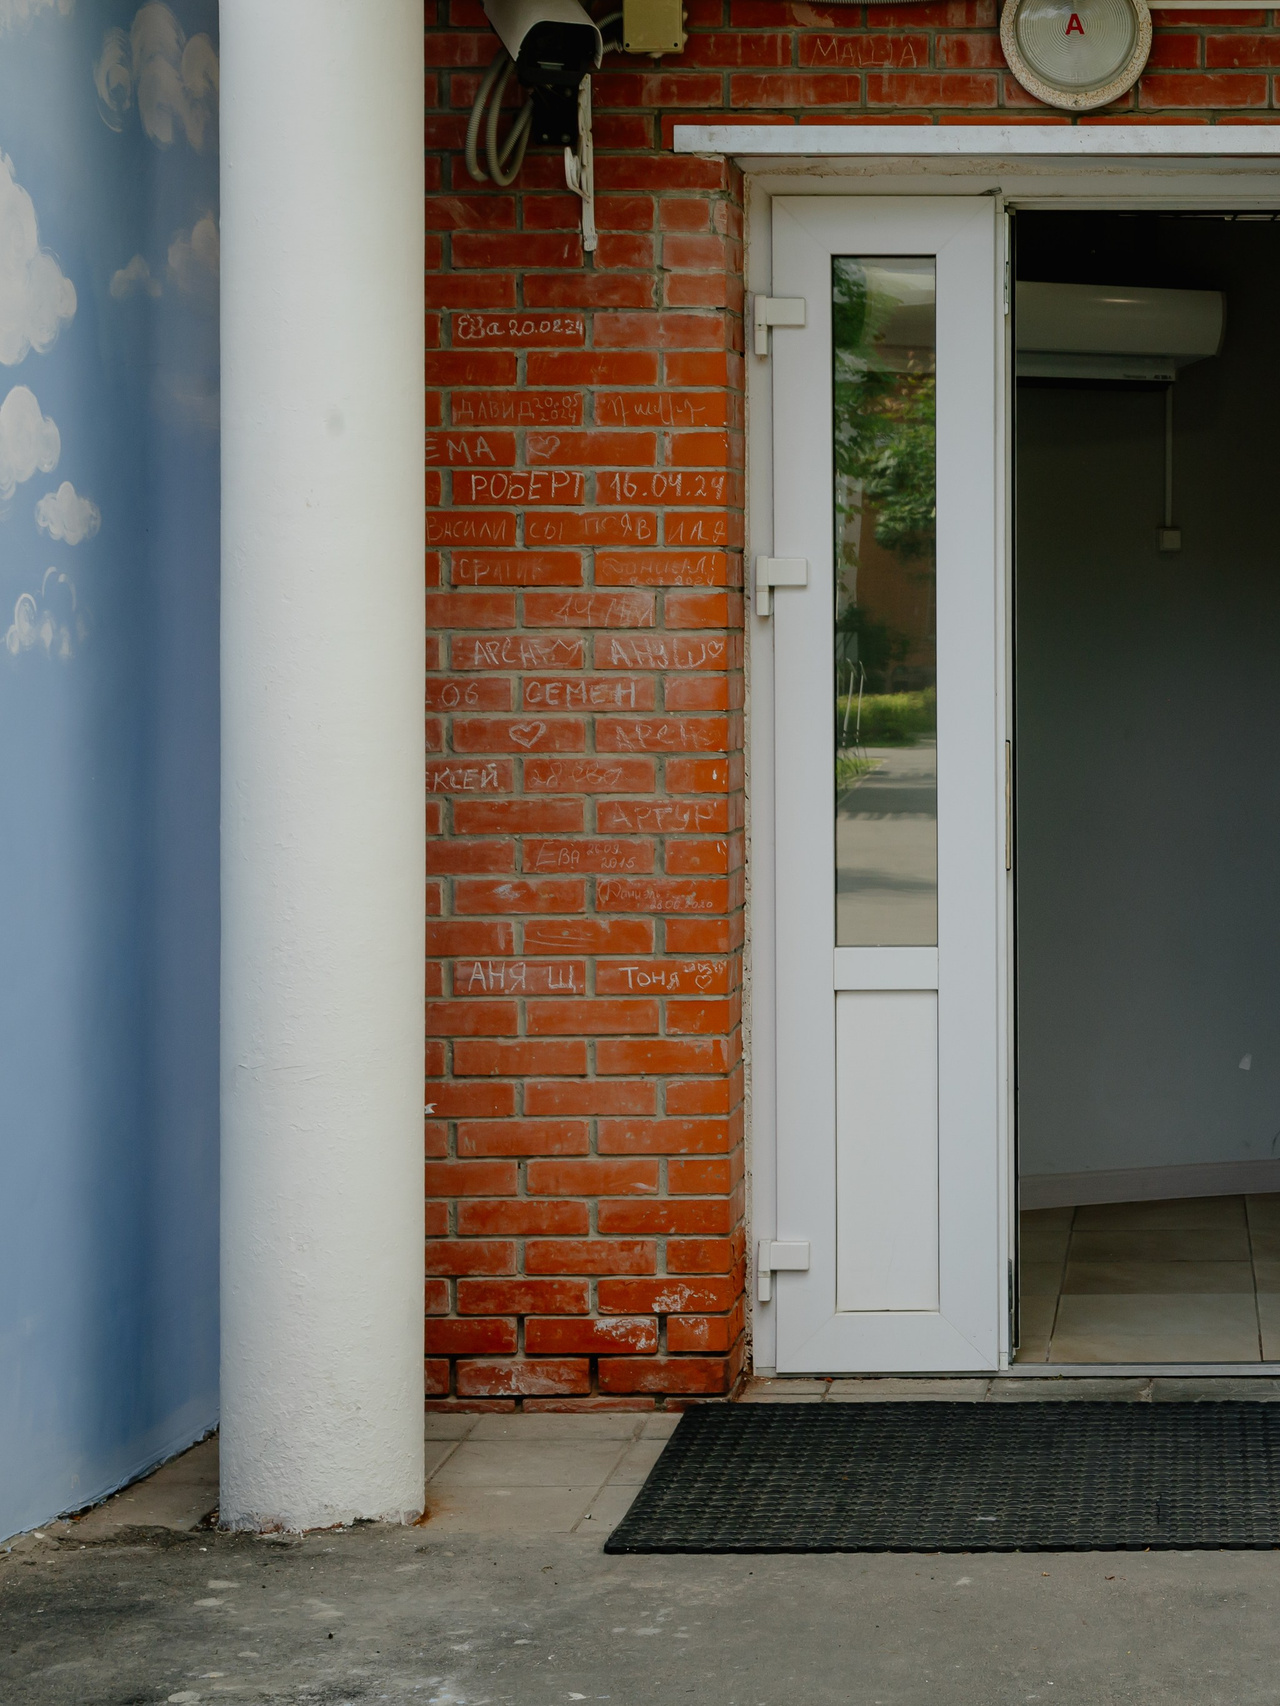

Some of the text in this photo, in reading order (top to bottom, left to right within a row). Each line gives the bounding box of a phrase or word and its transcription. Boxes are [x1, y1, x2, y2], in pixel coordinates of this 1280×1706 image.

[1065, 13, 1085, 36] А
[811, 38, 917, 68] МАША
[458, 399, 535, 423] ДАВИД
[470, 471, 585, 501] РОБЕРТ
[526, 681, 636, 708] СЕМЕН
[426, 762, 499, 792] КСЕЙ
[469, 962, 527, 992] АНЯ
